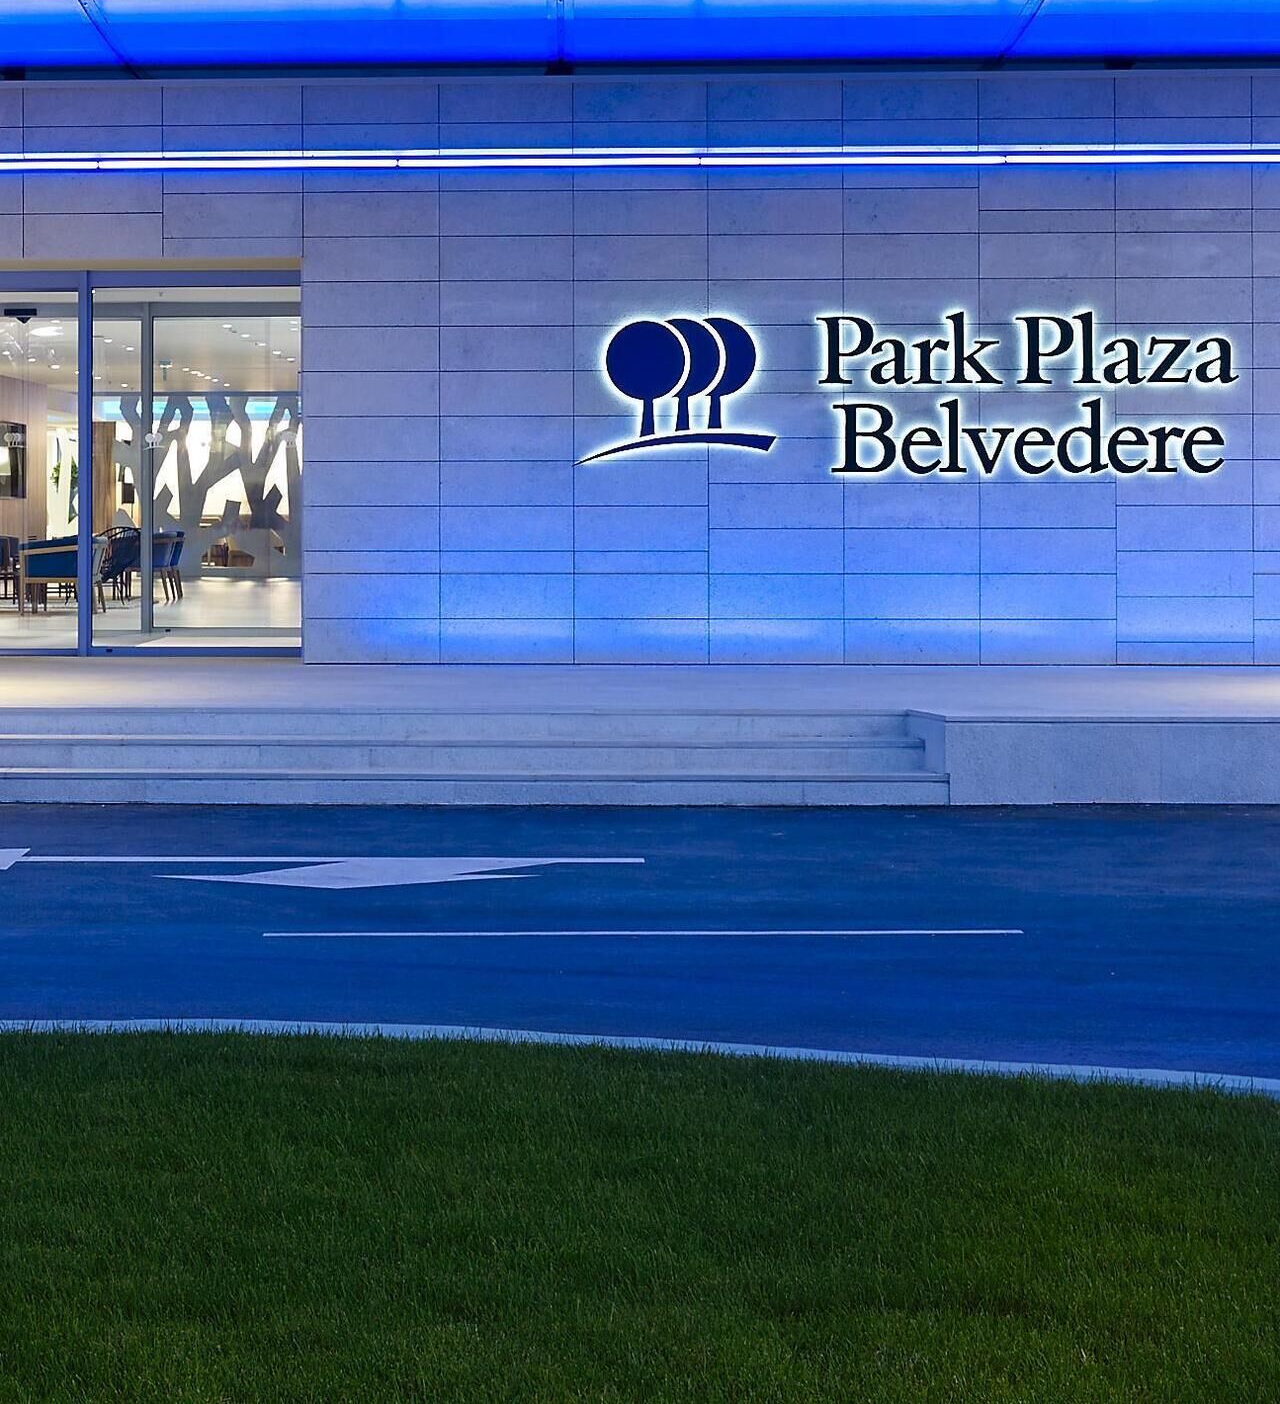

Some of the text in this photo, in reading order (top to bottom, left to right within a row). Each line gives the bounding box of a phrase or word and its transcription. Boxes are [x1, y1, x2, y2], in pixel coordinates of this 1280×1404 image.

[816, 311, 1239, 385] Park Plaza
[830, 397, 1226, 475] Belvedere
